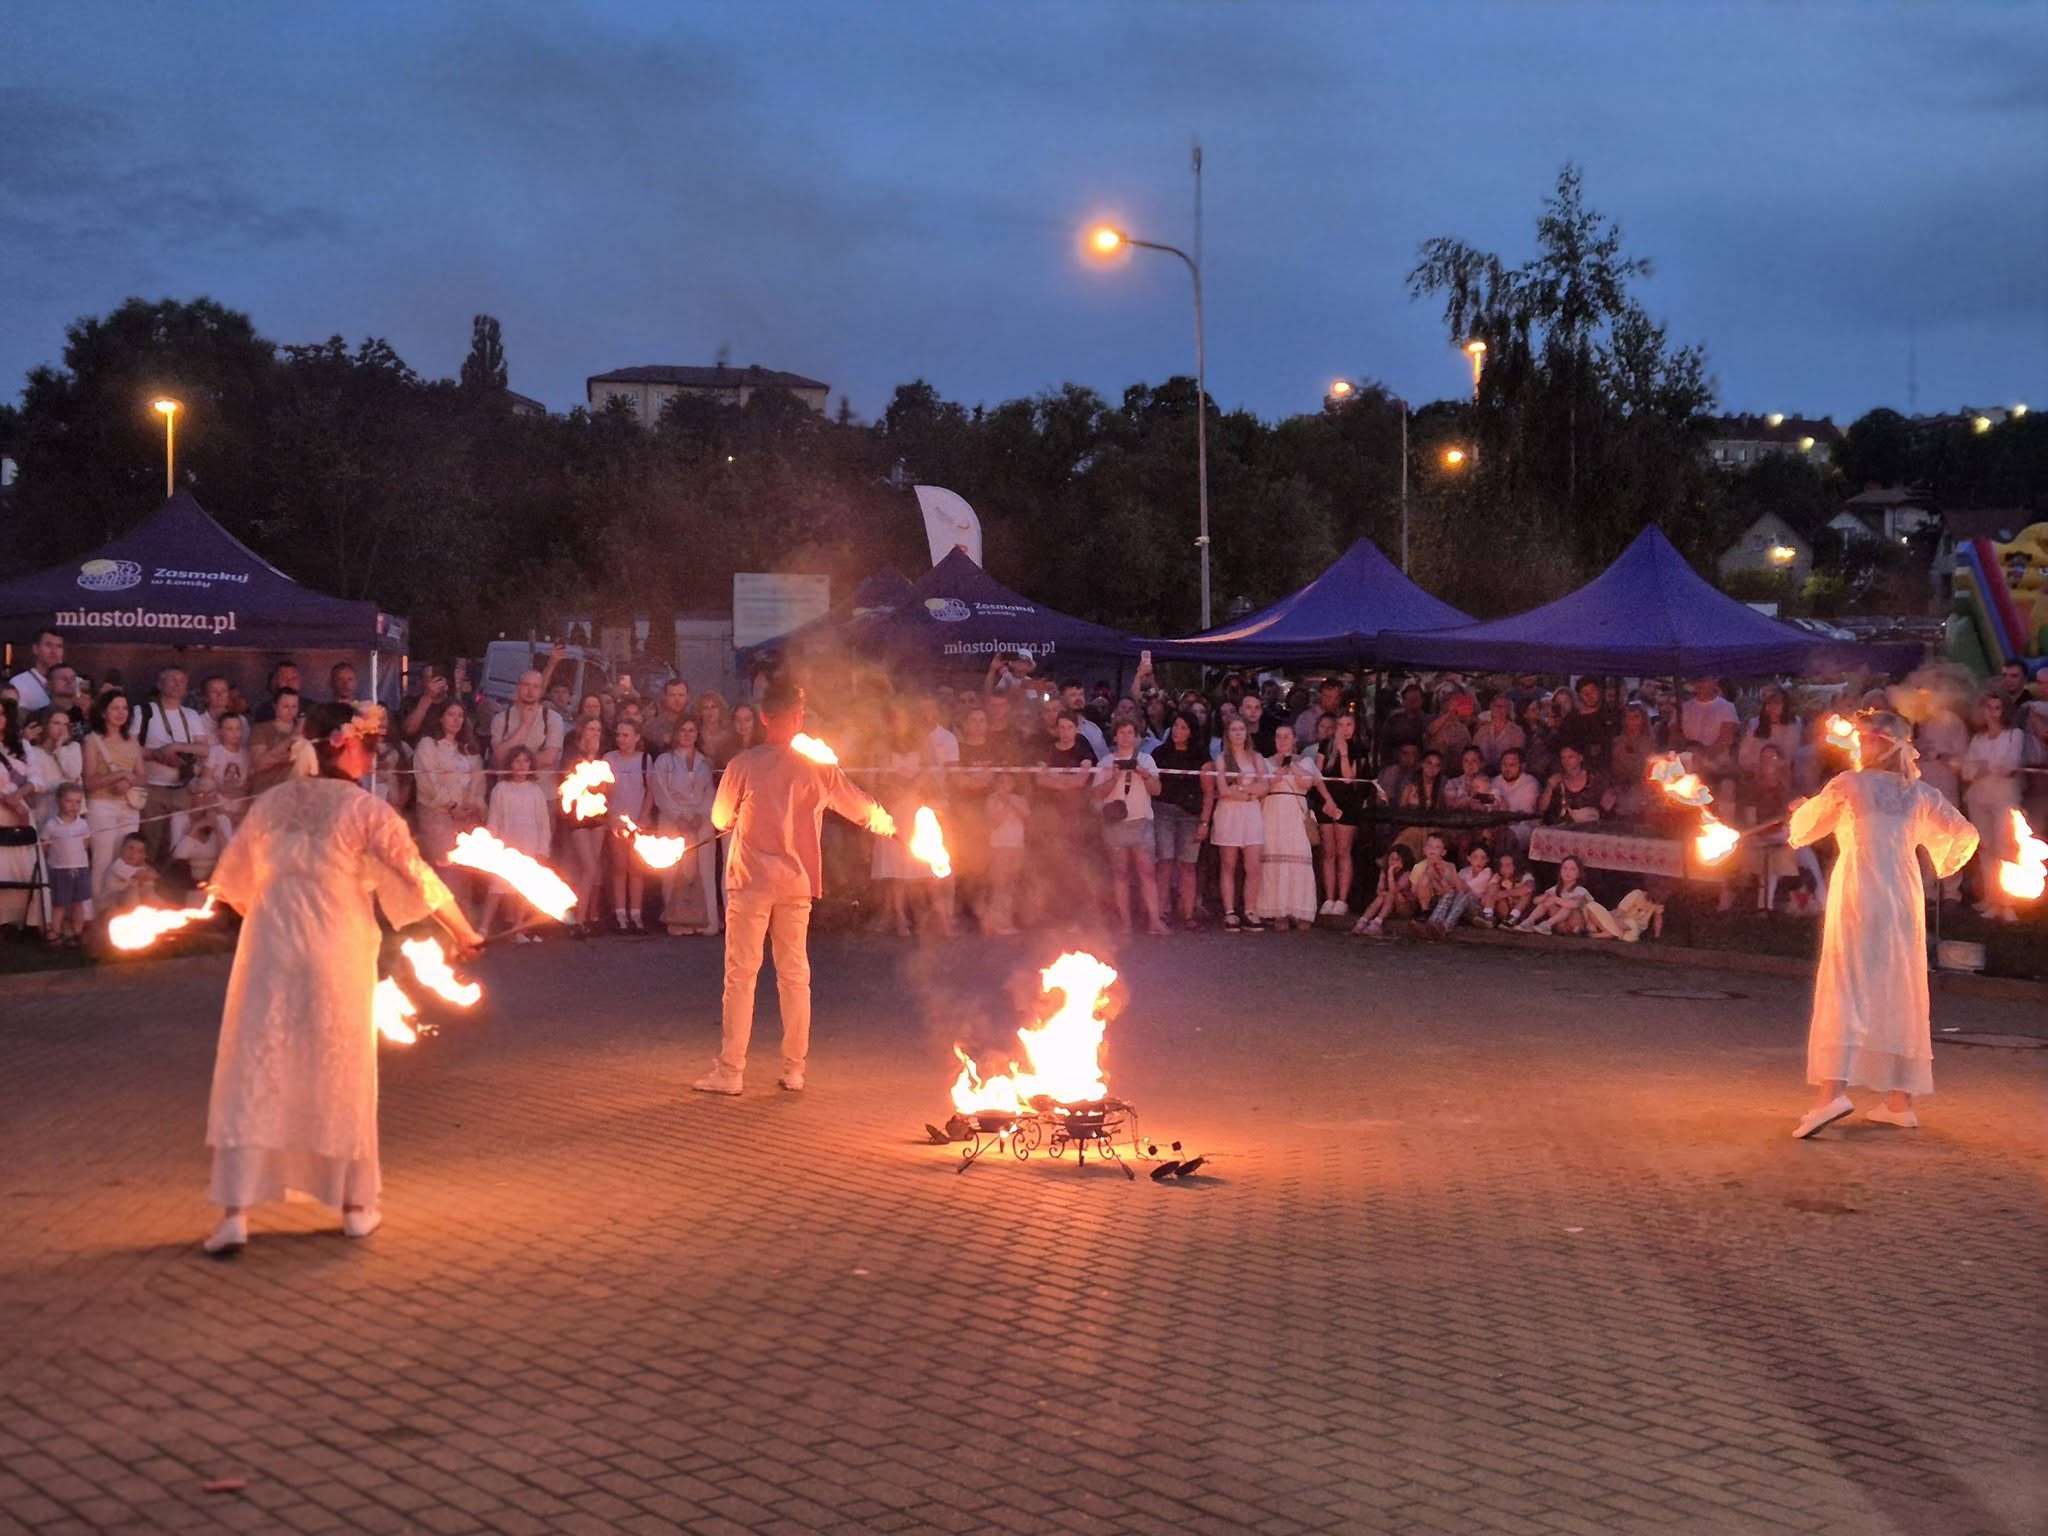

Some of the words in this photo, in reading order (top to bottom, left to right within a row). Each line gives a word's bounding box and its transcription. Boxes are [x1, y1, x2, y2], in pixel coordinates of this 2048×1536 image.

[153, 567, 249, 584] Zasmakuj
[55, 607, 237, 635] miastolomza.pl
[943, 639, 1056, 656] miastolomza.pl
